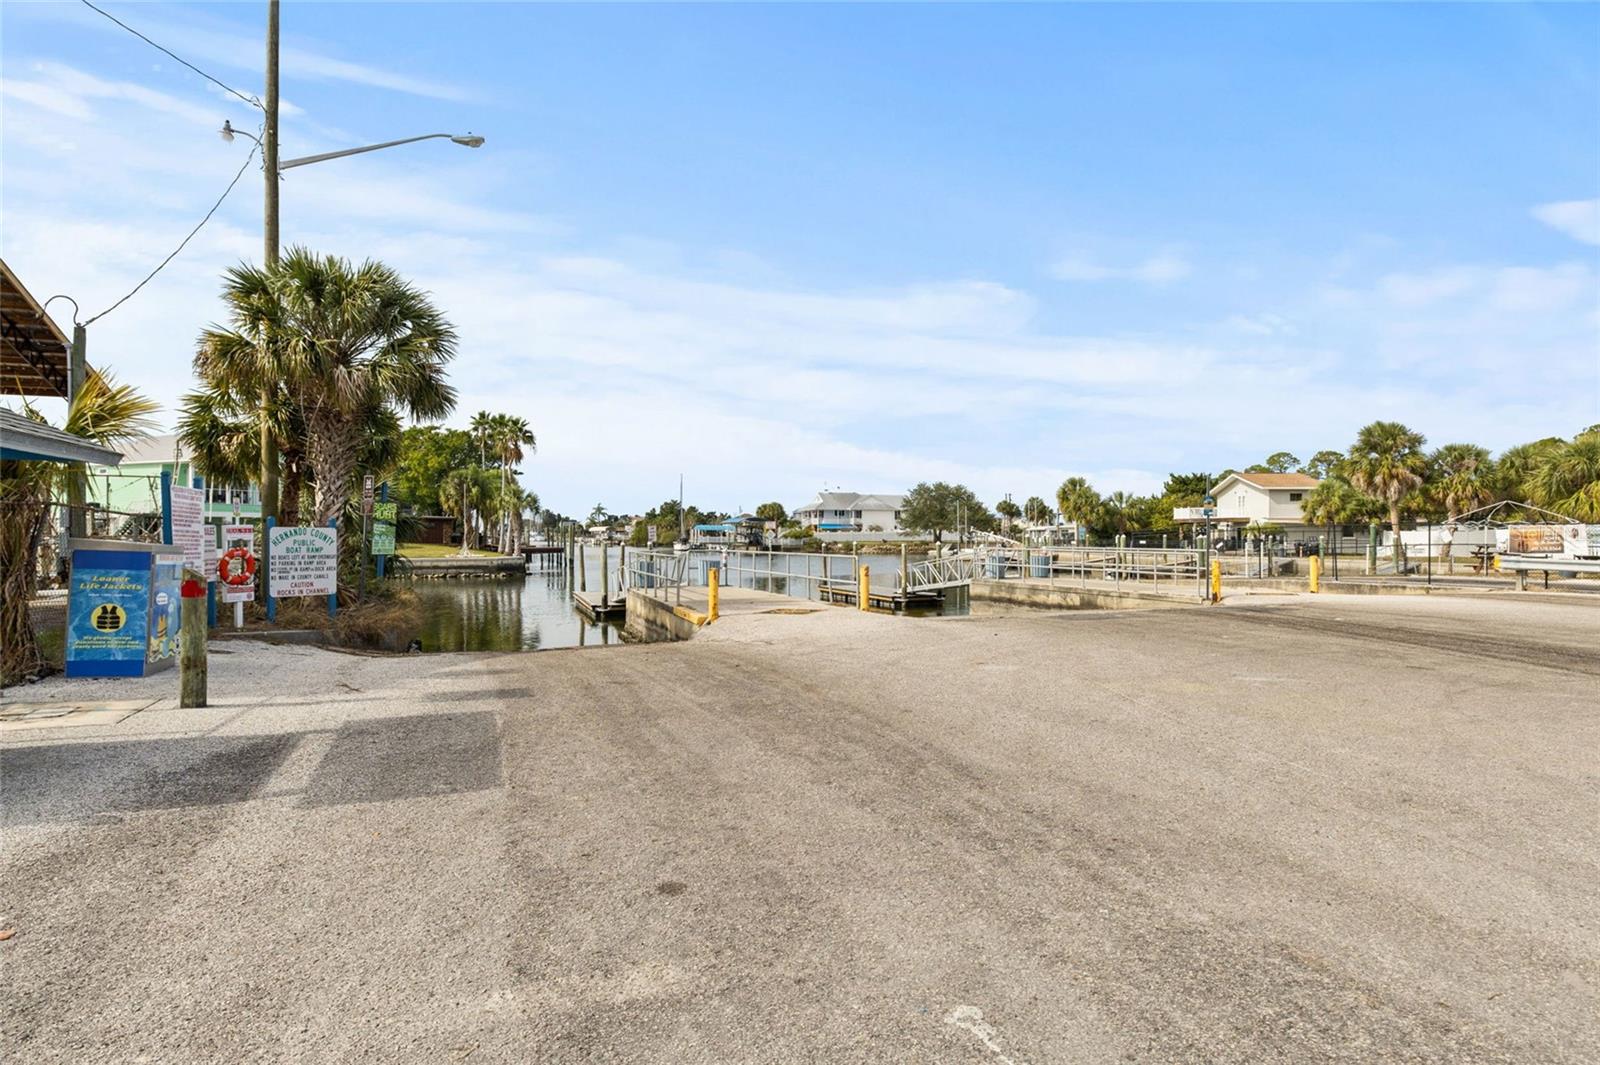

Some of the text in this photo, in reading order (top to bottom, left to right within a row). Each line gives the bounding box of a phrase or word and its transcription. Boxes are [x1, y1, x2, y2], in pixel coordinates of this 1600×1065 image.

[271, 528, 335, 547] HERNANDO COUNTY
[80, 582, 143, 591] Life Jackets
